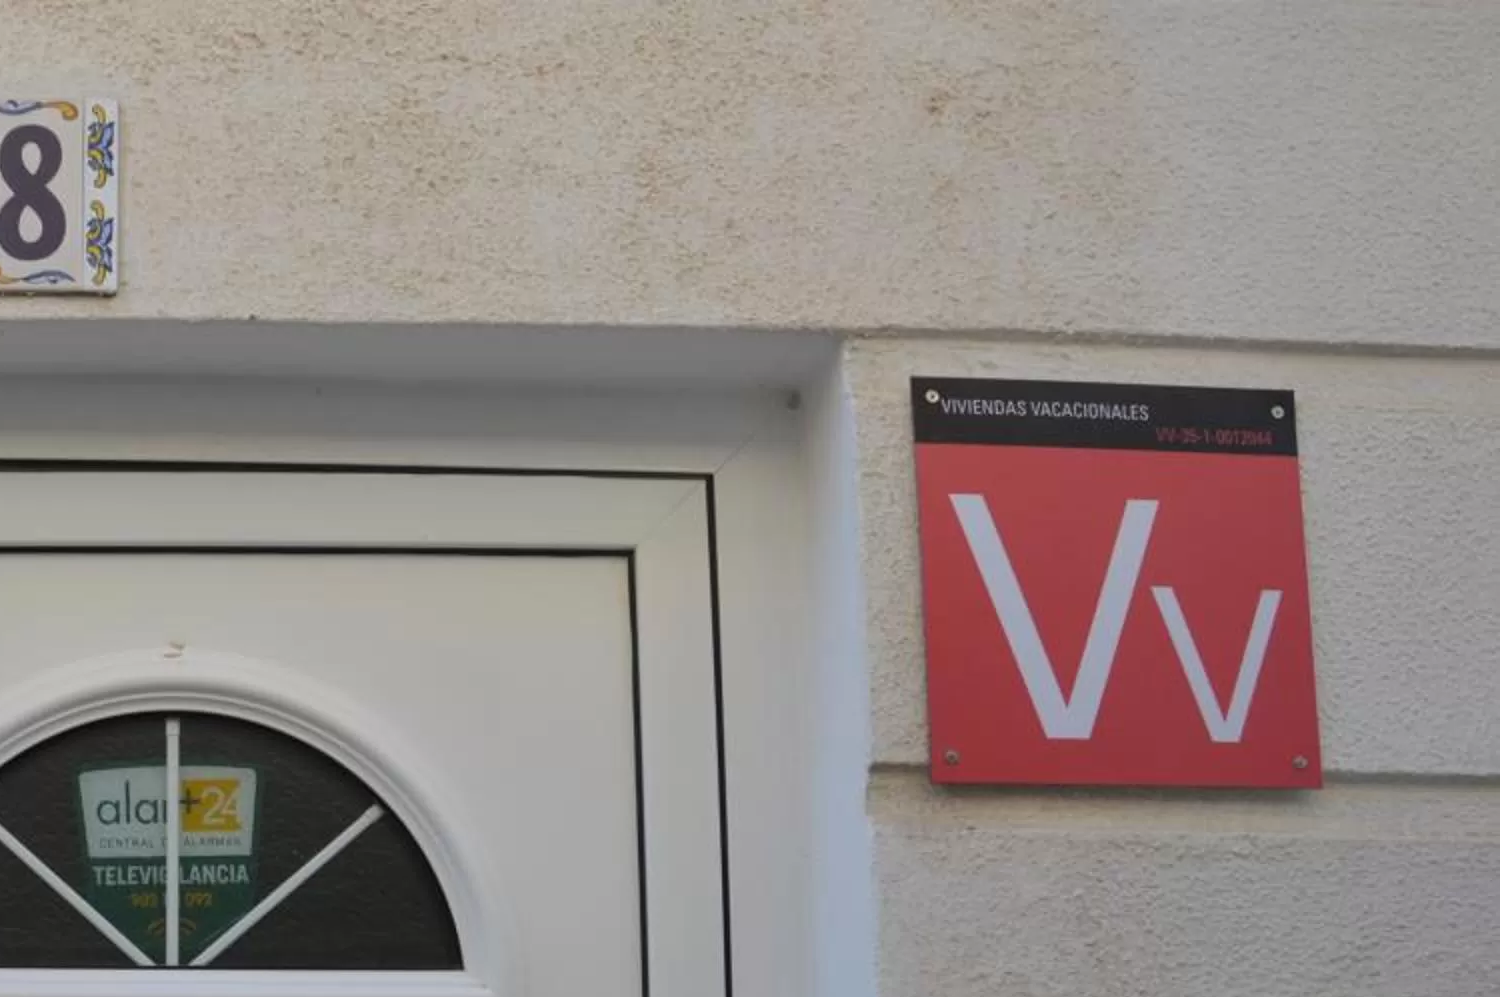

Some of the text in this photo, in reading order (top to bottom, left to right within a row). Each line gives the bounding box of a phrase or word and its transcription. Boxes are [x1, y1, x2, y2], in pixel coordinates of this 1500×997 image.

[940, 399, 1150, 421] VIVIENDAS VACACIONALES
[99, 836, 154, 849] CENTRAL
[92, 863, 250, 886] TELEVIGLANCIA
